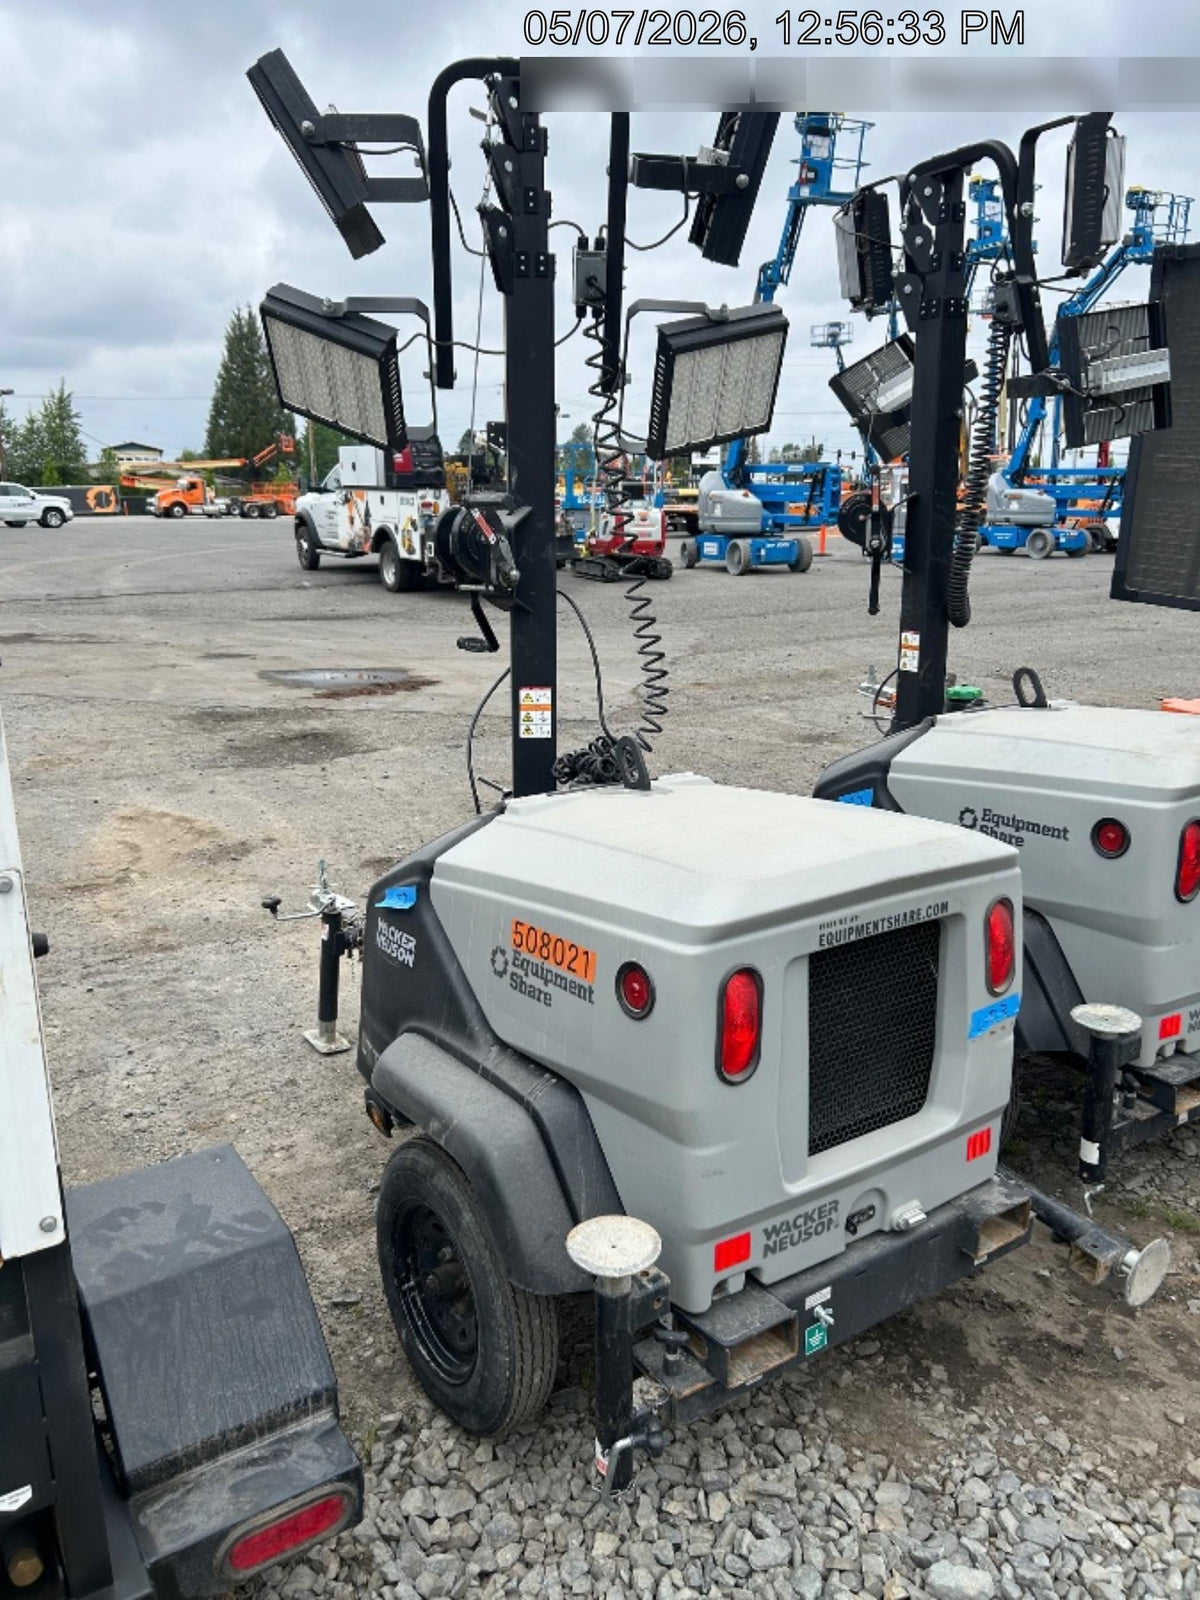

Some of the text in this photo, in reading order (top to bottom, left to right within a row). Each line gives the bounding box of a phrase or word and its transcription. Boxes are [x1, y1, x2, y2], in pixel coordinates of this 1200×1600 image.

[981, 808, 1069, 841] Equipment
[378, 917, 417, 952] WACKER
[819, 901, 949, 947] EQUIPMENTSHARE.COM
[376, 932, 416, 968] NEUSON
[513, 920, 590, 979] 508021
[509, 971, 552, 1007] Share
[511, 949, 595, 1005] Equipment
[762, 1199, 840, 1242] WACKER
